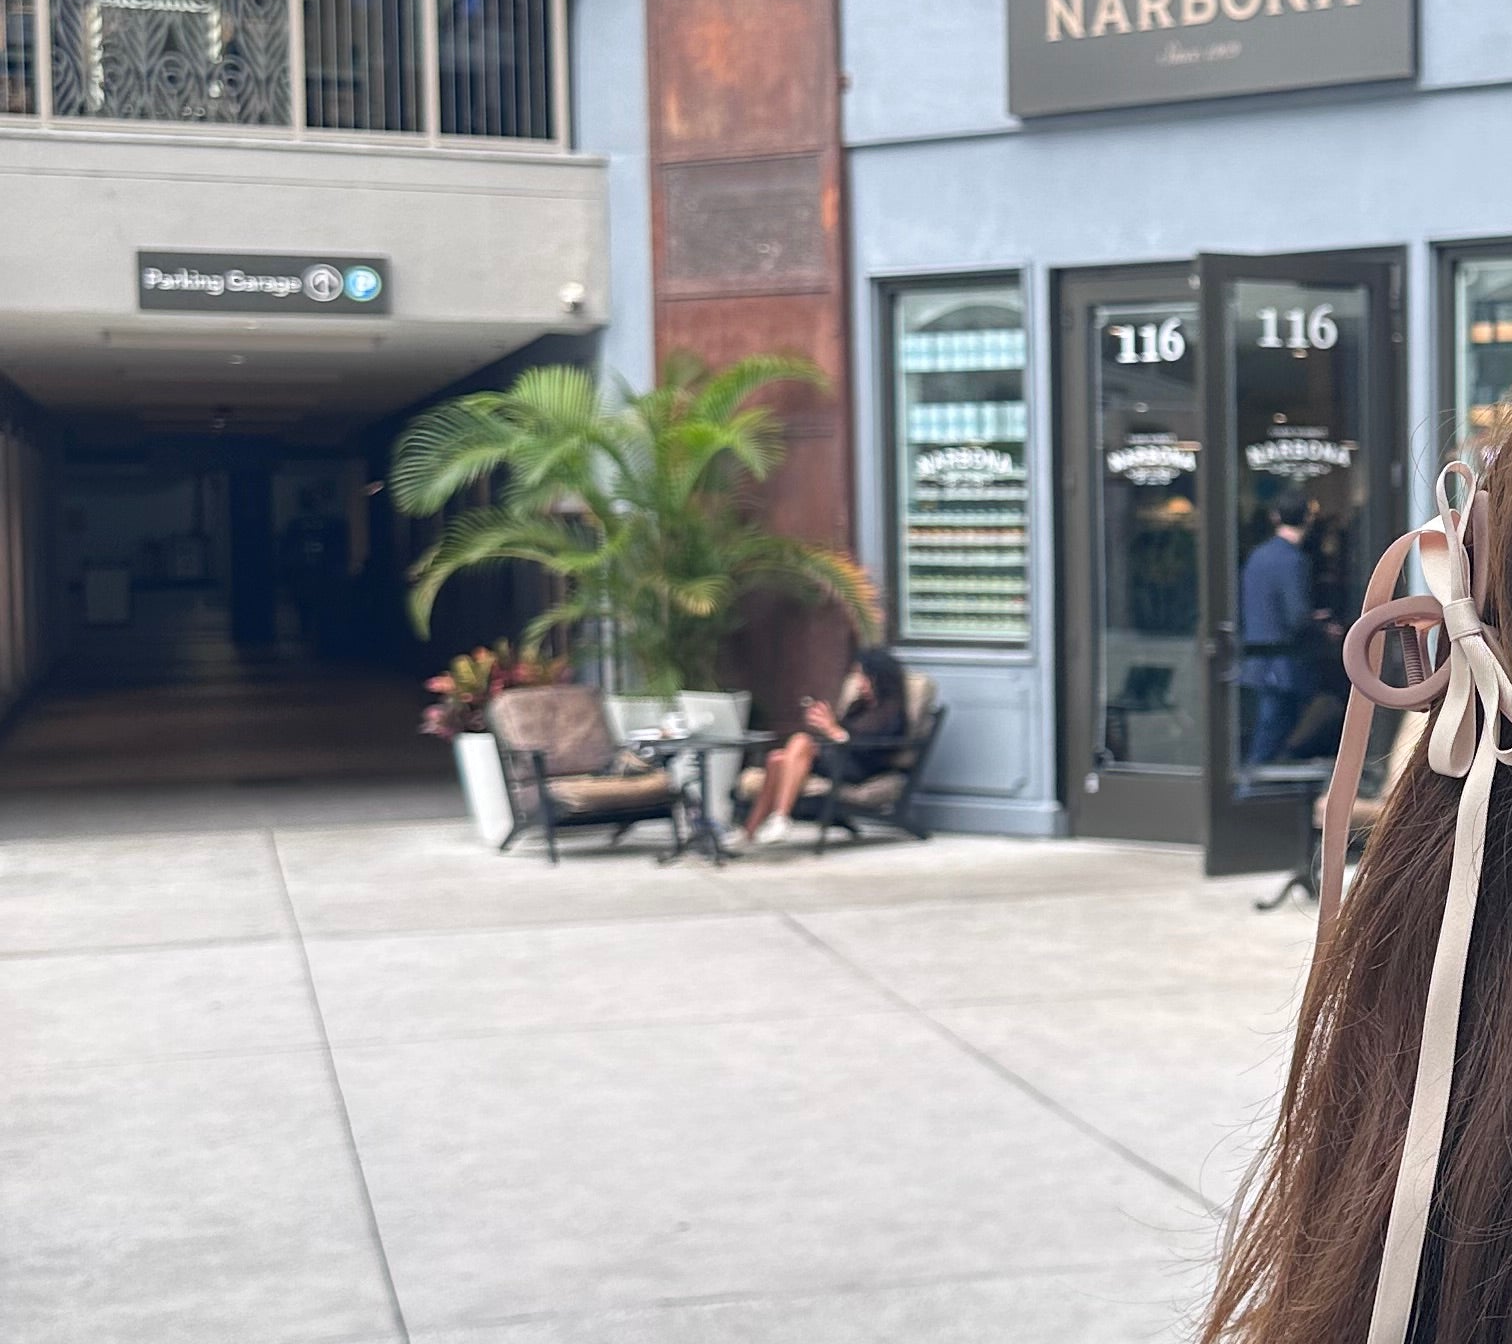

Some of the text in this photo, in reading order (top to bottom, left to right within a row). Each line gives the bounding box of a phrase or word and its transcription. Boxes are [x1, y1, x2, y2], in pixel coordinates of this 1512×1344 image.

[142, 267, 303, 297] Parking Garage
[1113, 317, 1186, 364] 116
[1256, 303, 1338, 350] 116
[1245, 438, 1351, 469] NARBONA
